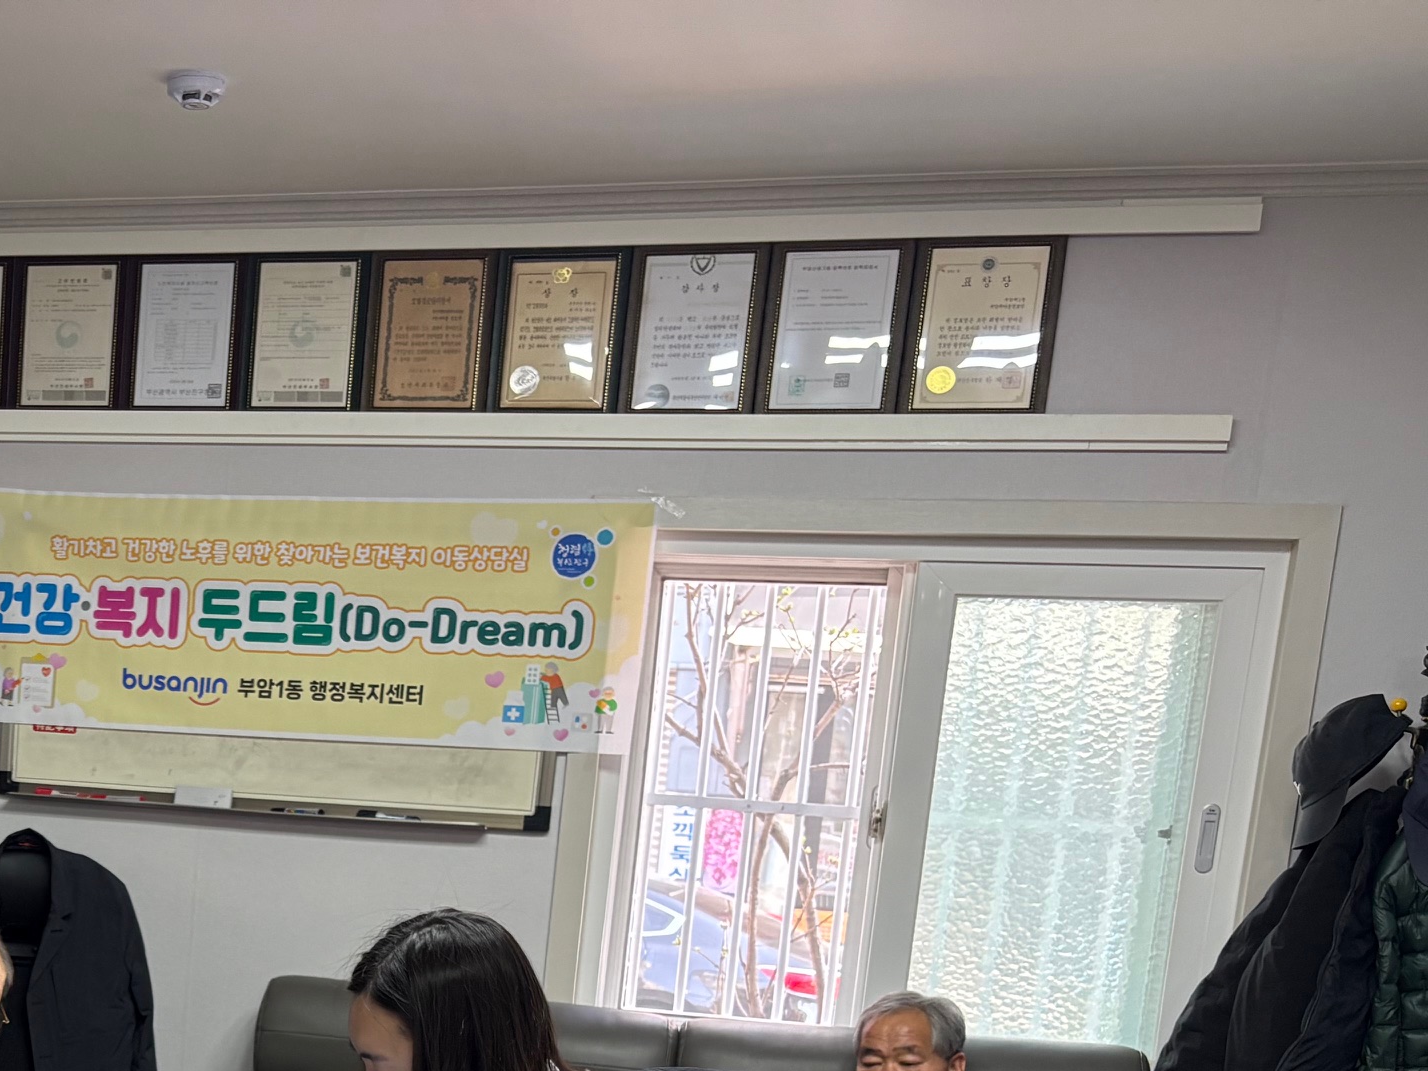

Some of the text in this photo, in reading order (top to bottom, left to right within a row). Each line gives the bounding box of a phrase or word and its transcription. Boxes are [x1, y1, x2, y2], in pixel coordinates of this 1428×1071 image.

[51, 535, 529, 572] 활기차고 건강한 노후를 위한 찾아가는 보건복지 이동상담실
[198, 588, 584, 651] 두드림(Do-Dream)
[122, 668, 228, 698] busanjin
[237, 678, 424, 705] 부암1동 행정복지센터
